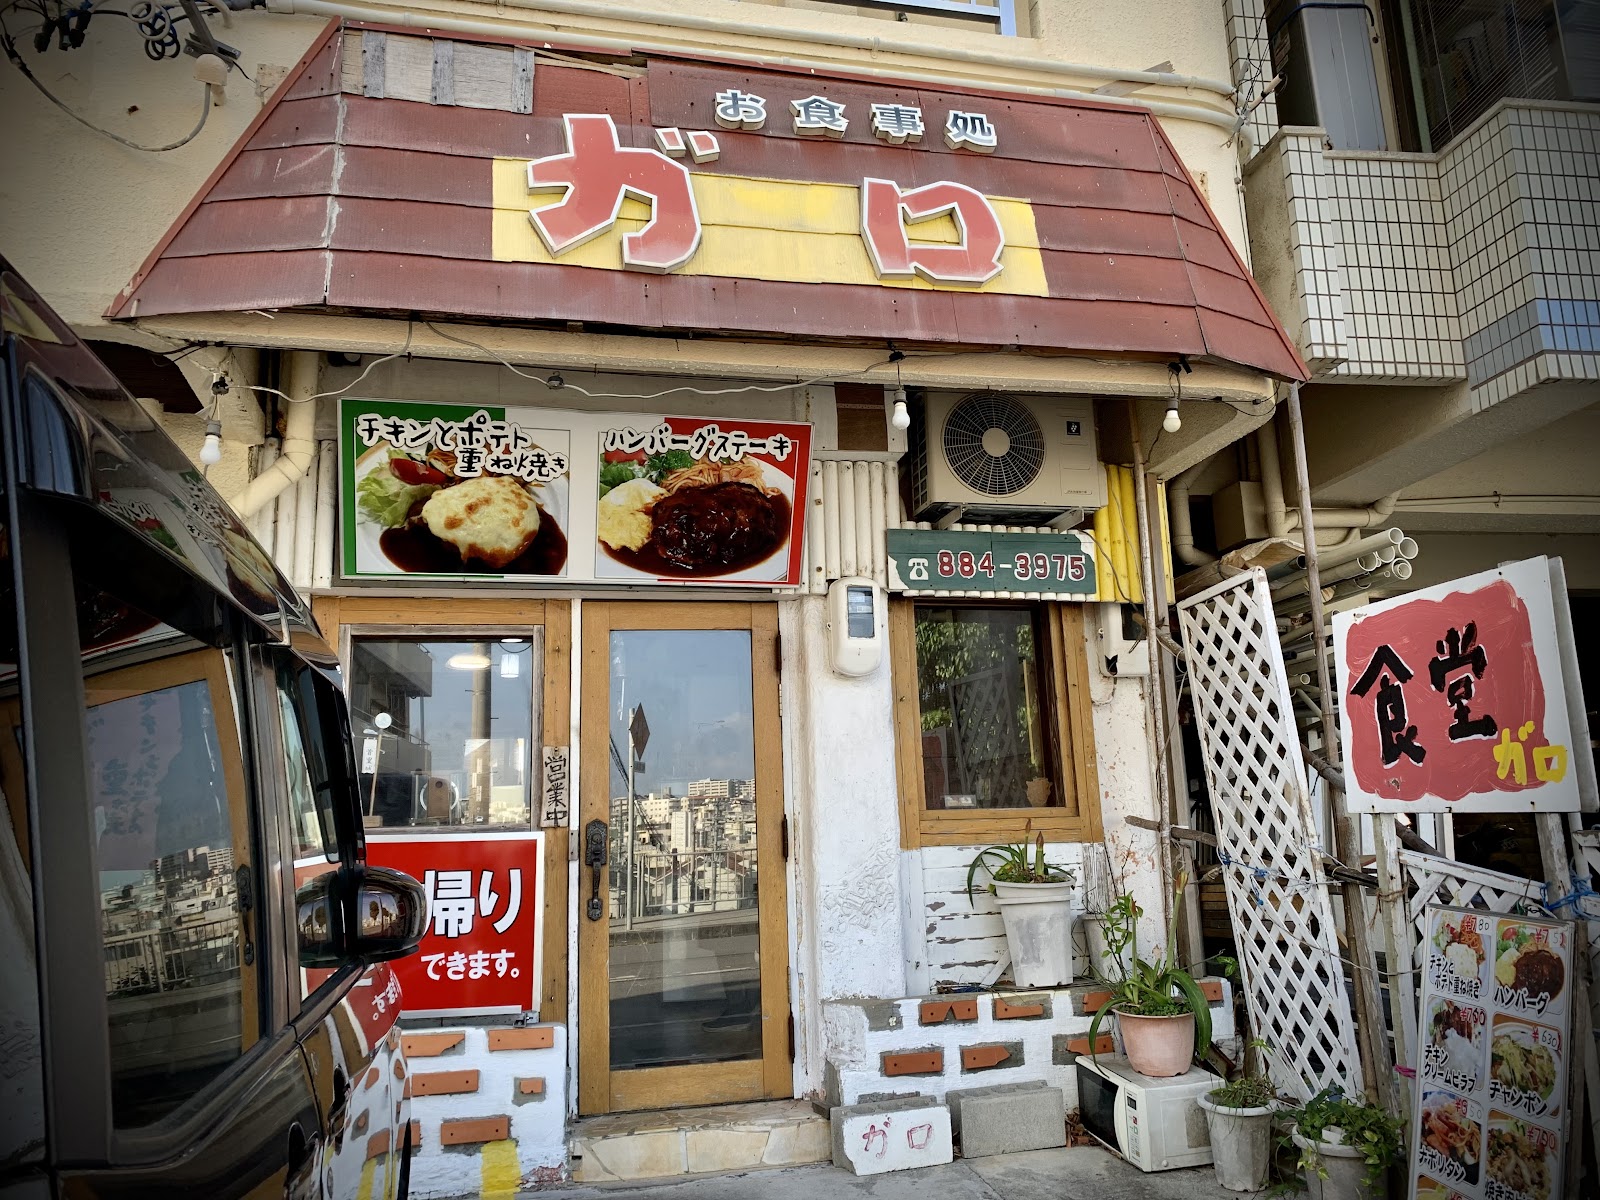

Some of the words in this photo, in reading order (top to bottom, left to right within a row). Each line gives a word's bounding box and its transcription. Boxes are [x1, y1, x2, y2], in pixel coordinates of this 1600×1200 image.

[714, 88, 998, 154] お食事処
[527, 113, 1005, 288] ガロ
[357, 410, 533, 452] チキンとポテト
[604, 424, 793, 462] ハンバーグステーキ
[455, 448, 569, 481] 重ね焼き
[938, 550, 1086, 581] 884-3975
[1350, 620, 1498, 769] 食堂
[1493, 721, 1568, 785] ガロ
[545, 754, 568, 828] 営業中
[421, 949, 520, 981] できます。
[1425, 1045, 1449, 1065] チキン
[862, 1116, 932, 1159] ガロ
